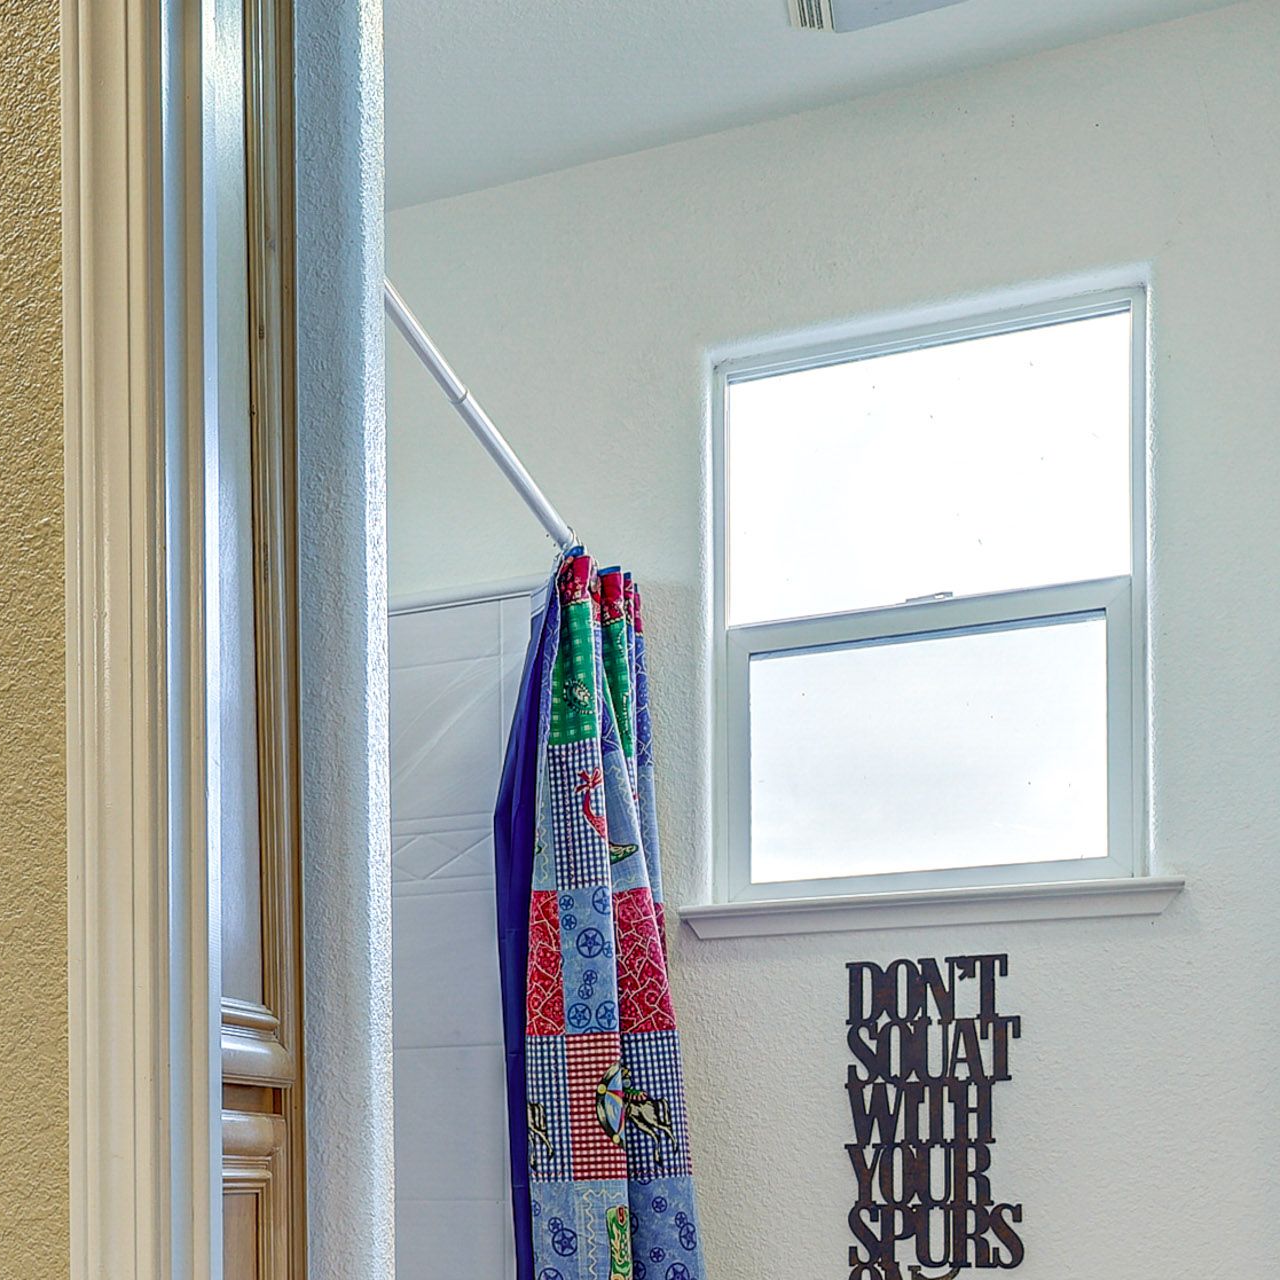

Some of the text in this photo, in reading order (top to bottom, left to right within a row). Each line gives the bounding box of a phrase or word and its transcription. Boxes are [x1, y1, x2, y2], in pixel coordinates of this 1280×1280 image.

[845, 953, 1009, 1026] DON'T
[846, 1015, 1022, 1085] SQUAT
[844, 1076, 996, 1145] WITH
[844, 1142, 994, 1207] YOUR
[847, 1202, 1025, 1269] SPURS
